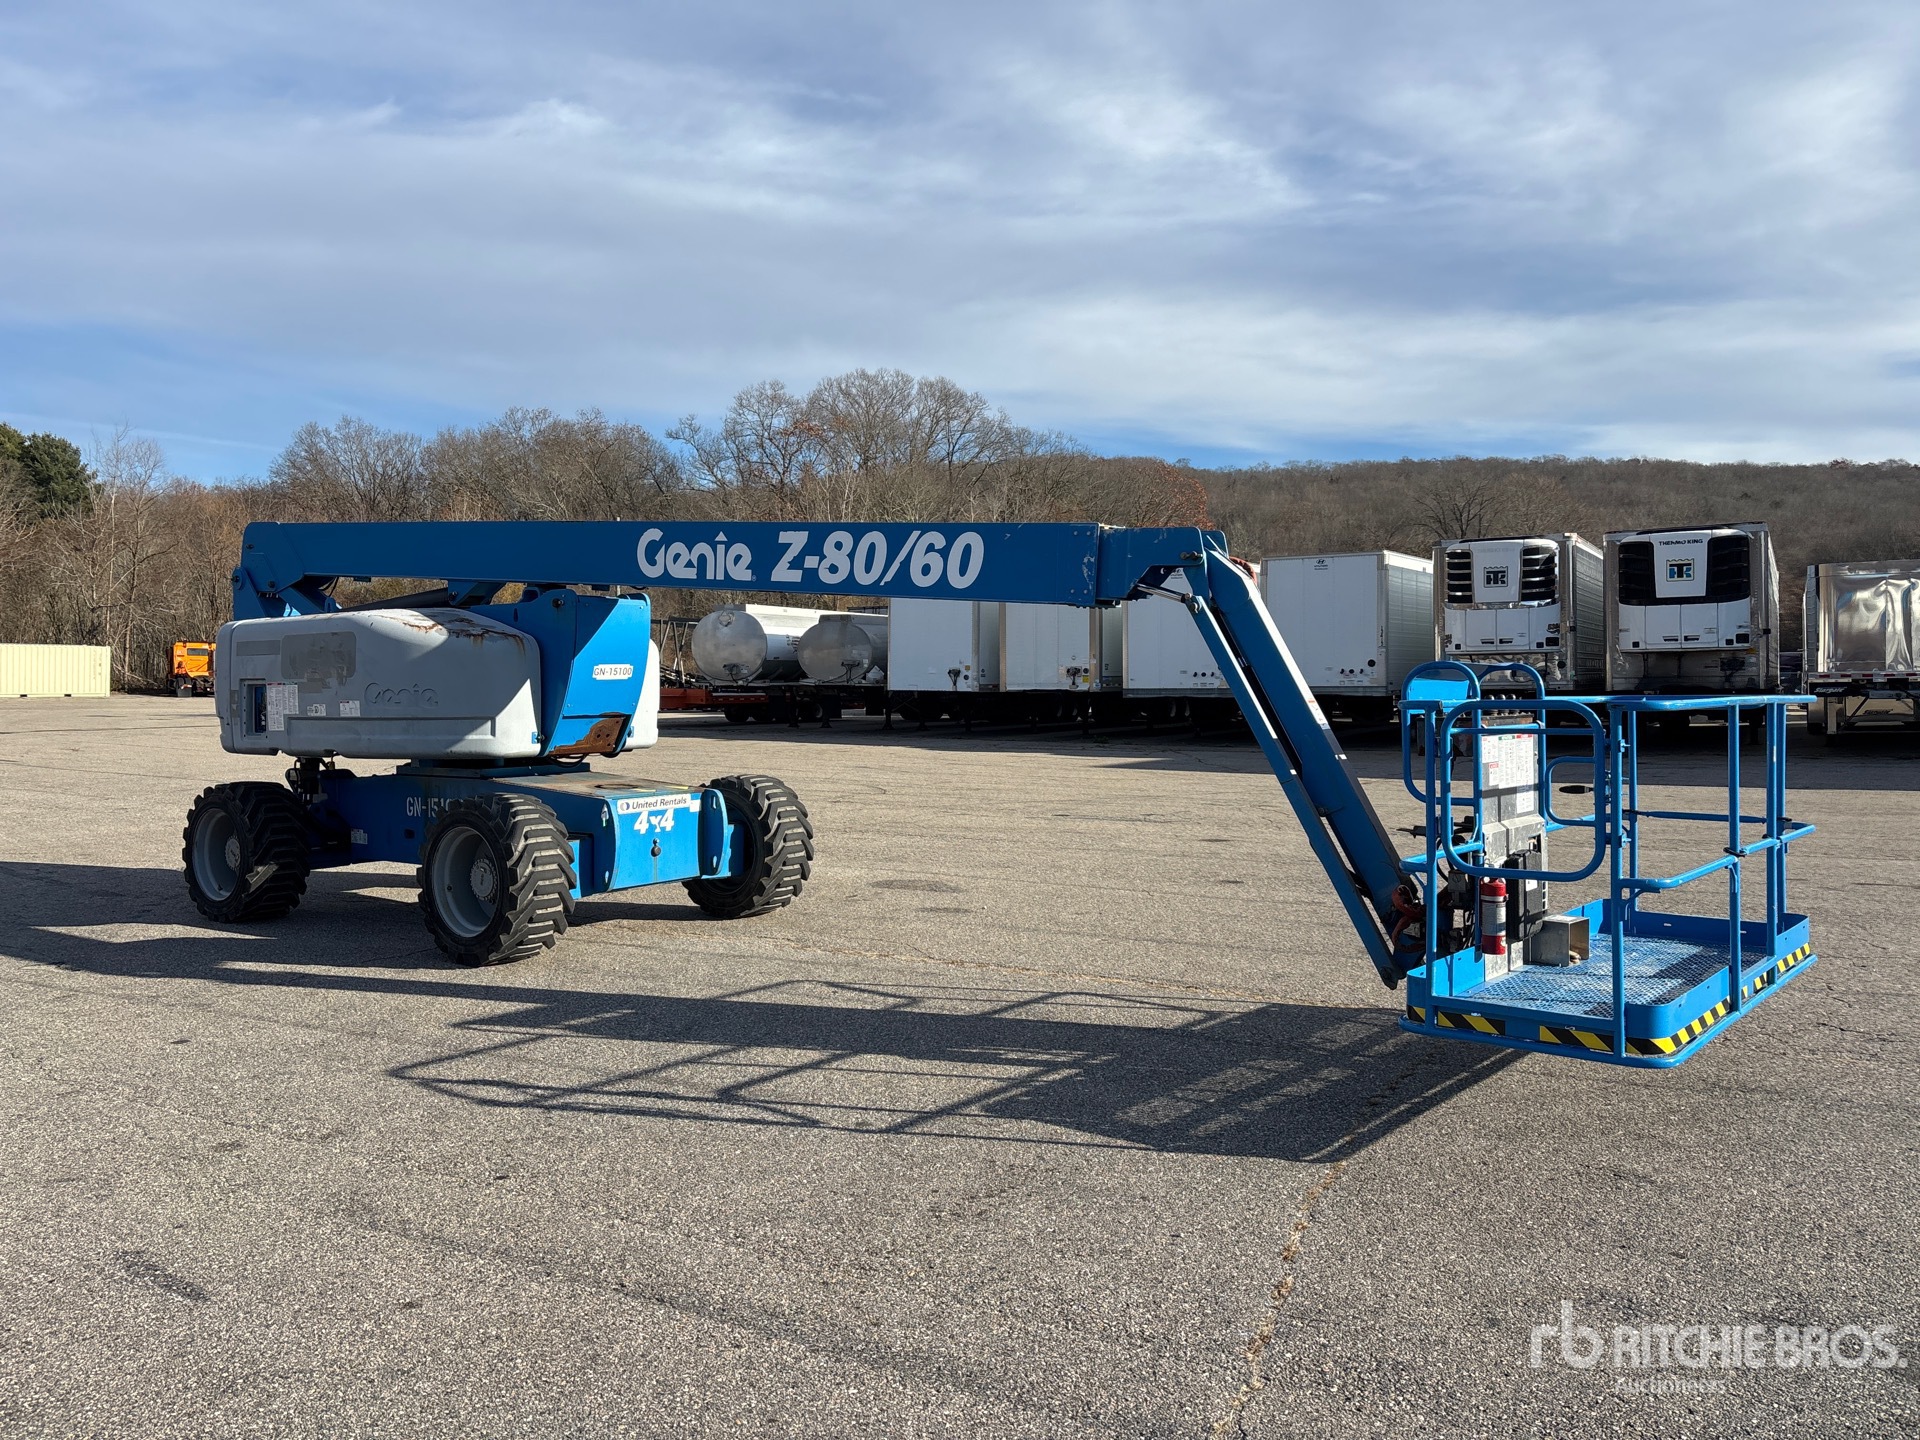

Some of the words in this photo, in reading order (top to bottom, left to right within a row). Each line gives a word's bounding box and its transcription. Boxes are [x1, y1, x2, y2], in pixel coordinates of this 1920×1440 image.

[637, 528, 752, 581] Genie
[771, 530, 985, 589] Z-80/60
[593, 667, 632, 676] GN-15100
[632, 801, 658, 810] United
[660, 796, 687, 807] Rentals
